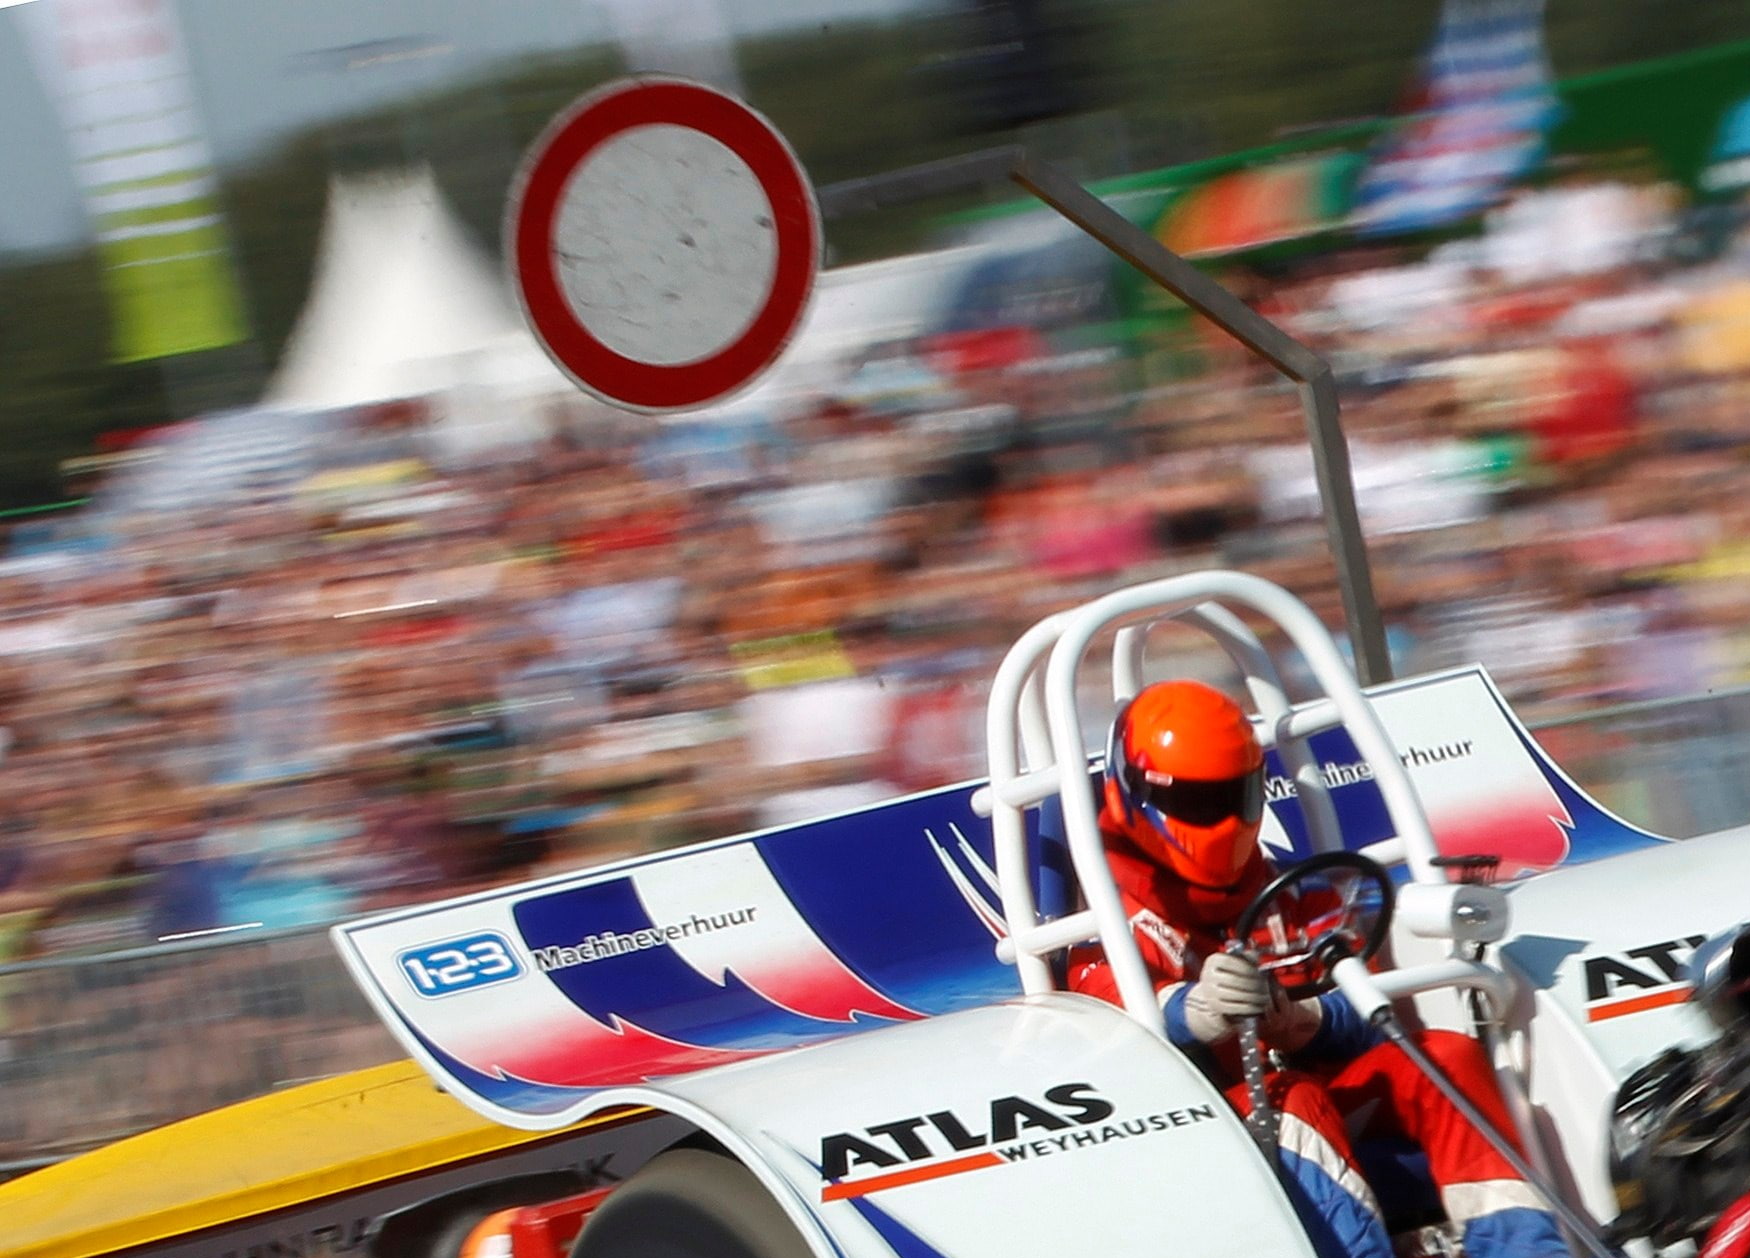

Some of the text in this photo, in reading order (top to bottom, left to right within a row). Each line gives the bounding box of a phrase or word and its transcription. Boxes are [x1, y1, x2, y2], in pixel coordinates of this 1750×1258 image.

[1263, 739, 1473, 802] Mainerhuur
[532, 906, 757, 972] Machineverhuur
[1584, 933, 1707, 1001] AT
[821, 1083, 1114, 1181] ATLAS
[1000, 1103, 1218, 1163] WEYHAUSEN
